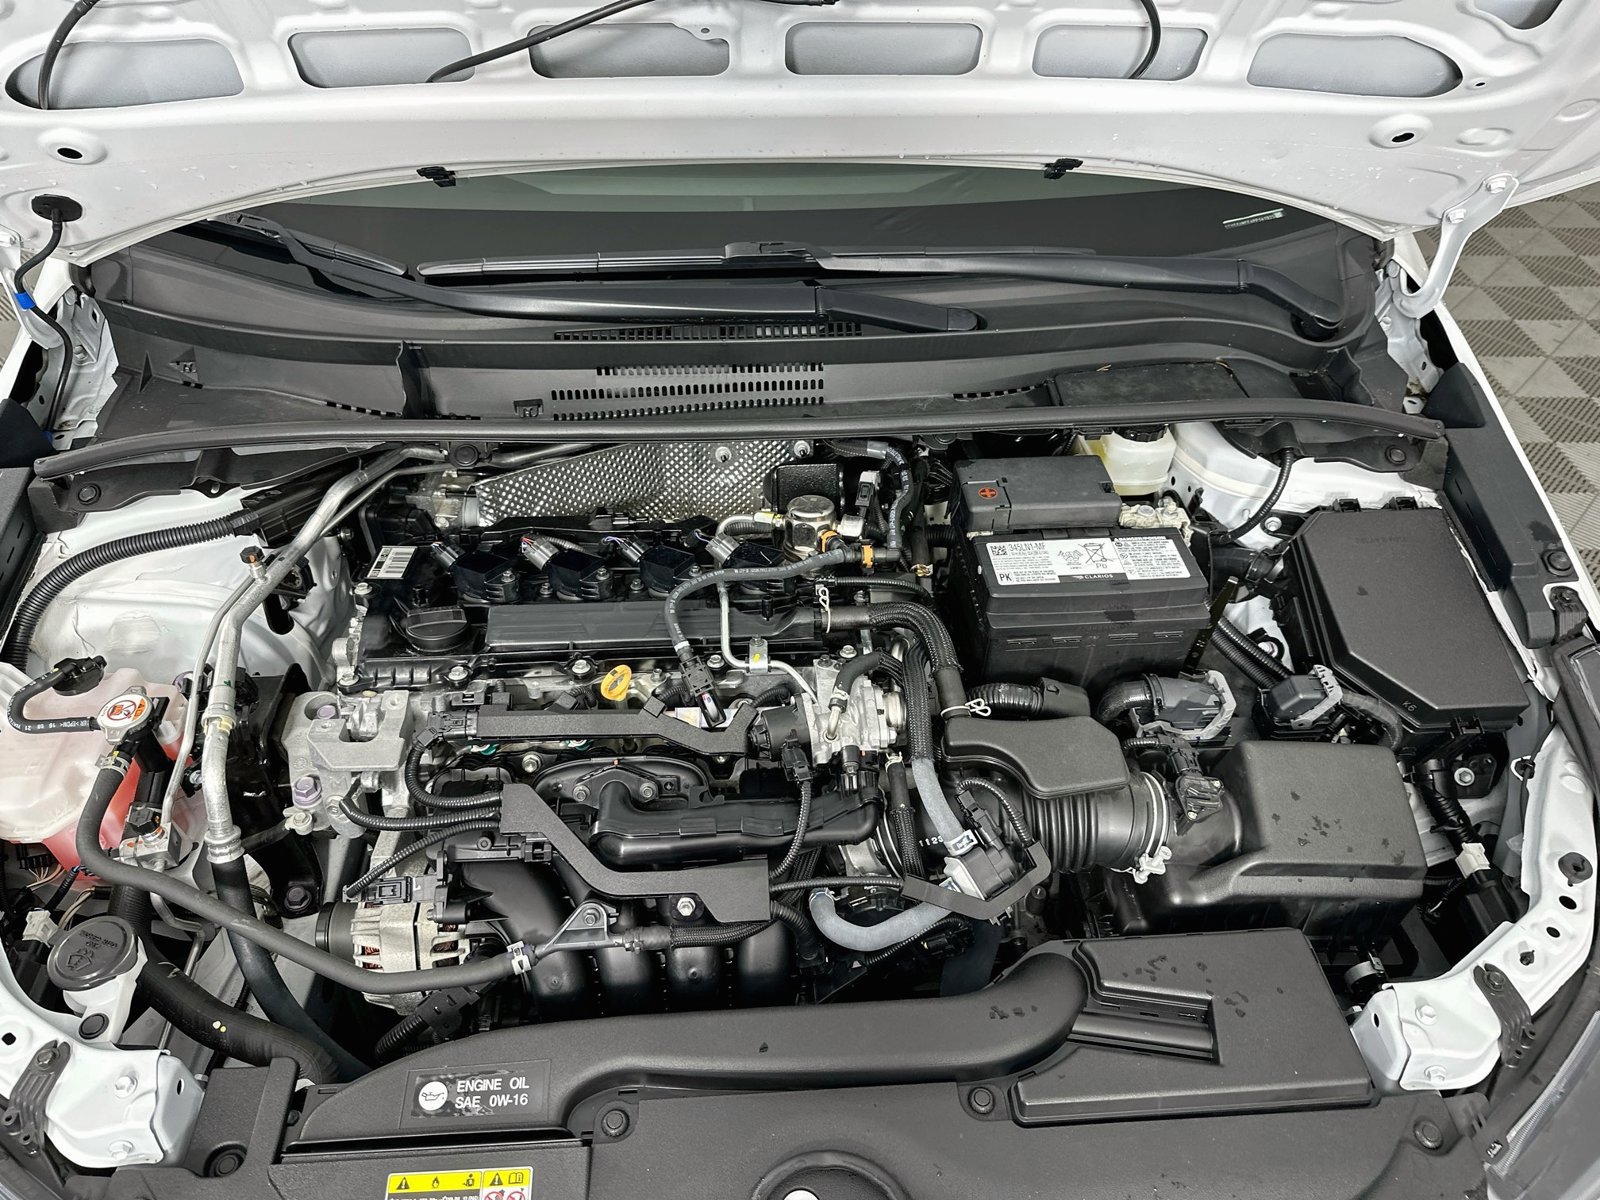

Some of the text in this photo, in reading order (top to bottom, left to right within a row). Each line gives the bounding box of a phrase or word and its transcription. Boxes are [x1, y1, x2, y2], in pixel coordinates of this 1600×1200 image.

[999, 573, 1013, 582] PK
[456, 1076, 530, 1093] ENGINE OIL
[454, 1093, 529, 1109] SAE 0W-16
